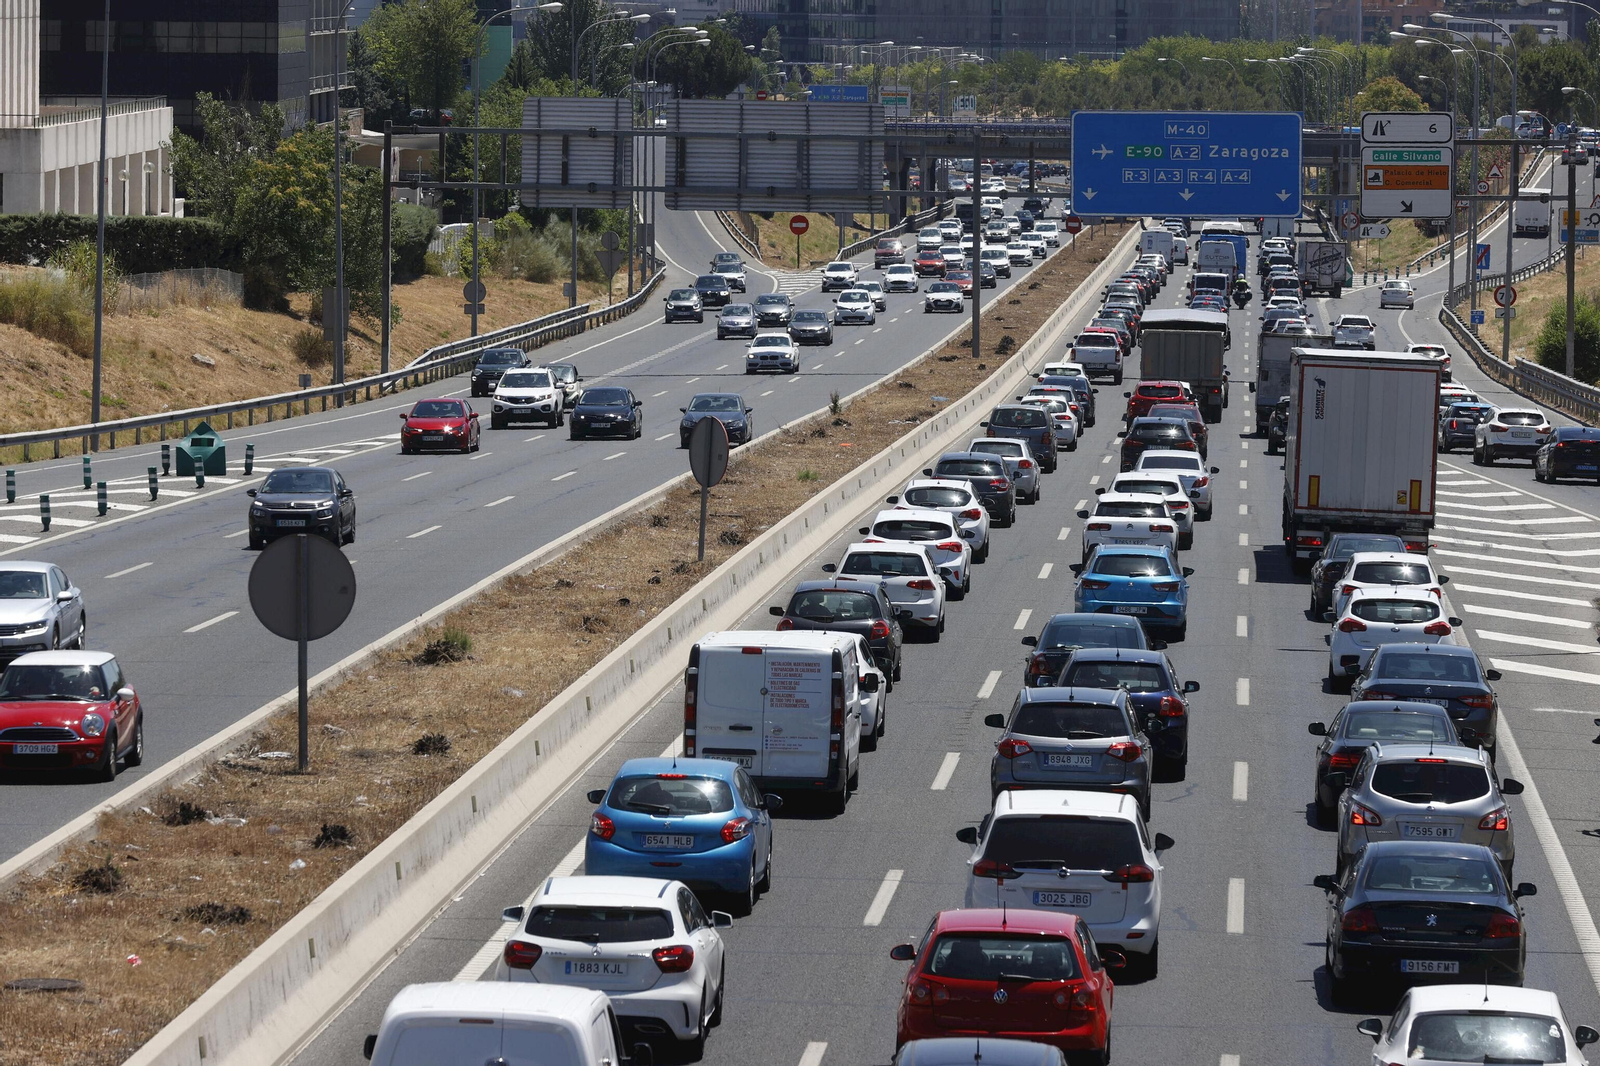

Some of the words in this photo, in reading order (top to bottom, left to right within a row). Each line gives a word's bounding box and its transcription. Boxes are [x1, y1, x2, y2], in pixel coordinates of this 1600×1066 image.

[1167, 125, 1206, 135] M-40
[1429, 123, 1438, 133] 6
[1126, 146, 1162, 157] E-90
[1173, 147, 1199, 158] A-2
[1209, 145, 1289, 160] Zaragoza
[1373, 152, 1398, 160] calle
[1403, 152, 1440, 160] Silvano
[1124, 171, 1147, 181] R-3
[1157, 172, 1180, 181] A-3
[1190, 172, 1214, 181] R-4
[1223, 172, 1248, 181] A-4
[18, 745, 39, 753] 3709
[41, 745, 56, 753] HGZ
[1050, 755, 1072, 764] 8948
[1074, 756, 1090, 764] JXG
[1410, 826, 1433, 836] 7595
[1436, 827, 1454, 837] GWT
[646, 836, 670, 845] 6541
[673, 836, 692, 846] HLB
[1040, 893, 1066, 903] 3025
[1070, 894, 1089, 904] JBG
[574, 963, 600, 973] 1883
[603, 963, 624, 974] KJL
[1408, 961, 1434, 971] 9156
[1437, 962, 1456, 972] FMT
